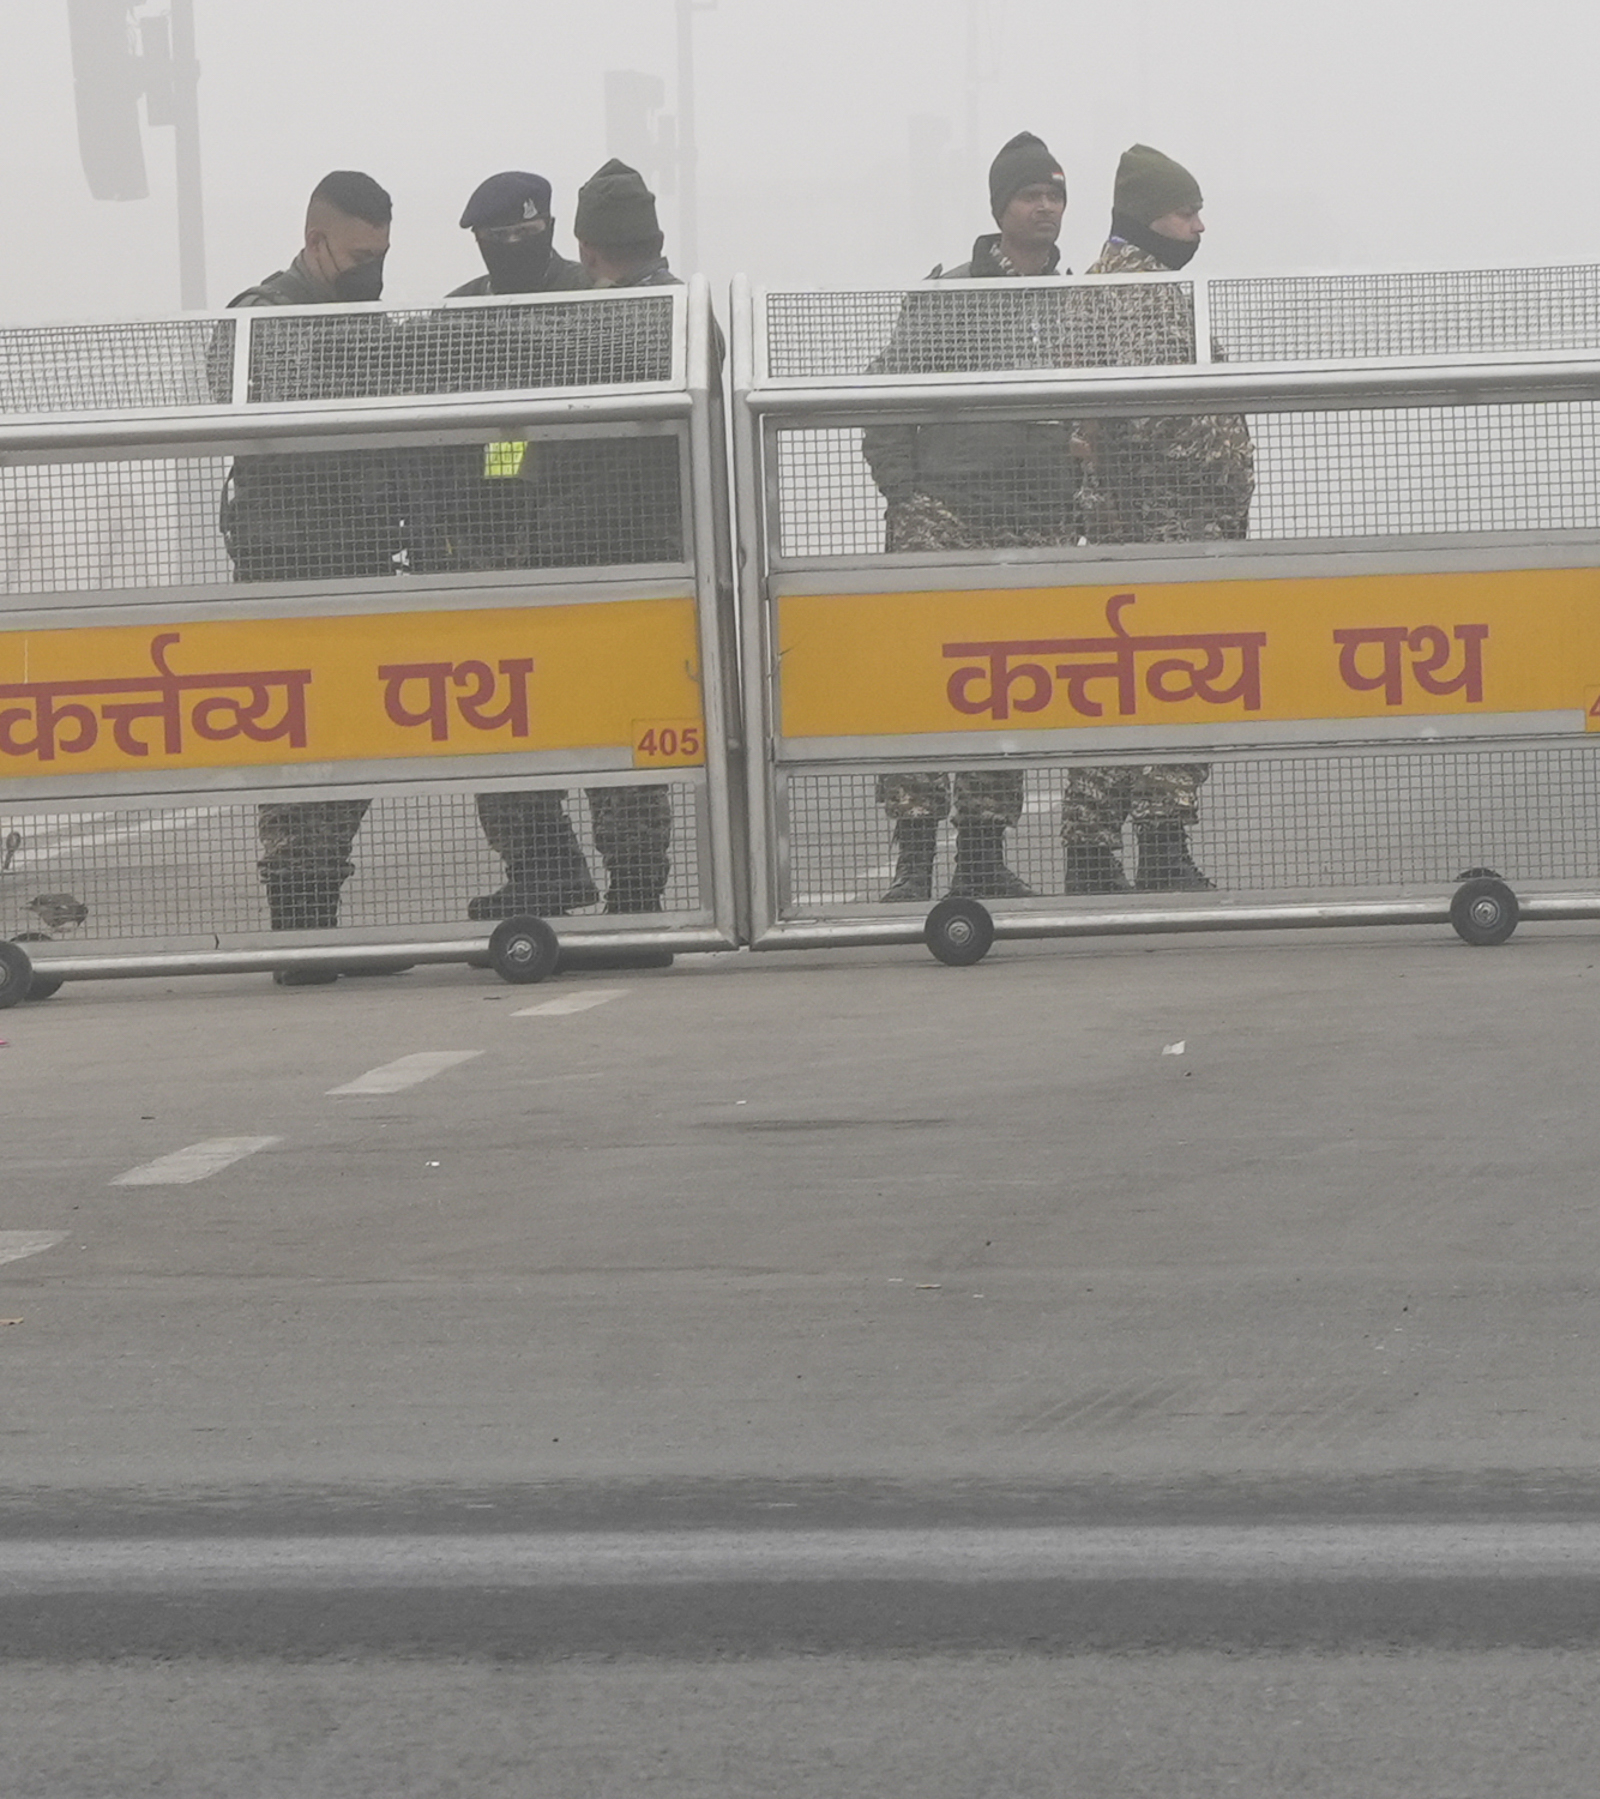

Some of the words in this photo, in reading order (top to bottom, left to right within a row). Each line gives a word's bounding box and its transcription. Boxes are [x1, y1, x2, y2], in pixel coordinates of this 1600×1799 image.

[0, 633, 313, 762] कर्त्तव्य
[378, 658, 535, 742] पथ
[942, 594, 1267, 720] कर्त्तव्य
[1333, 624, 1490, 706] पथ
[637, 728, 700, 758] 405
